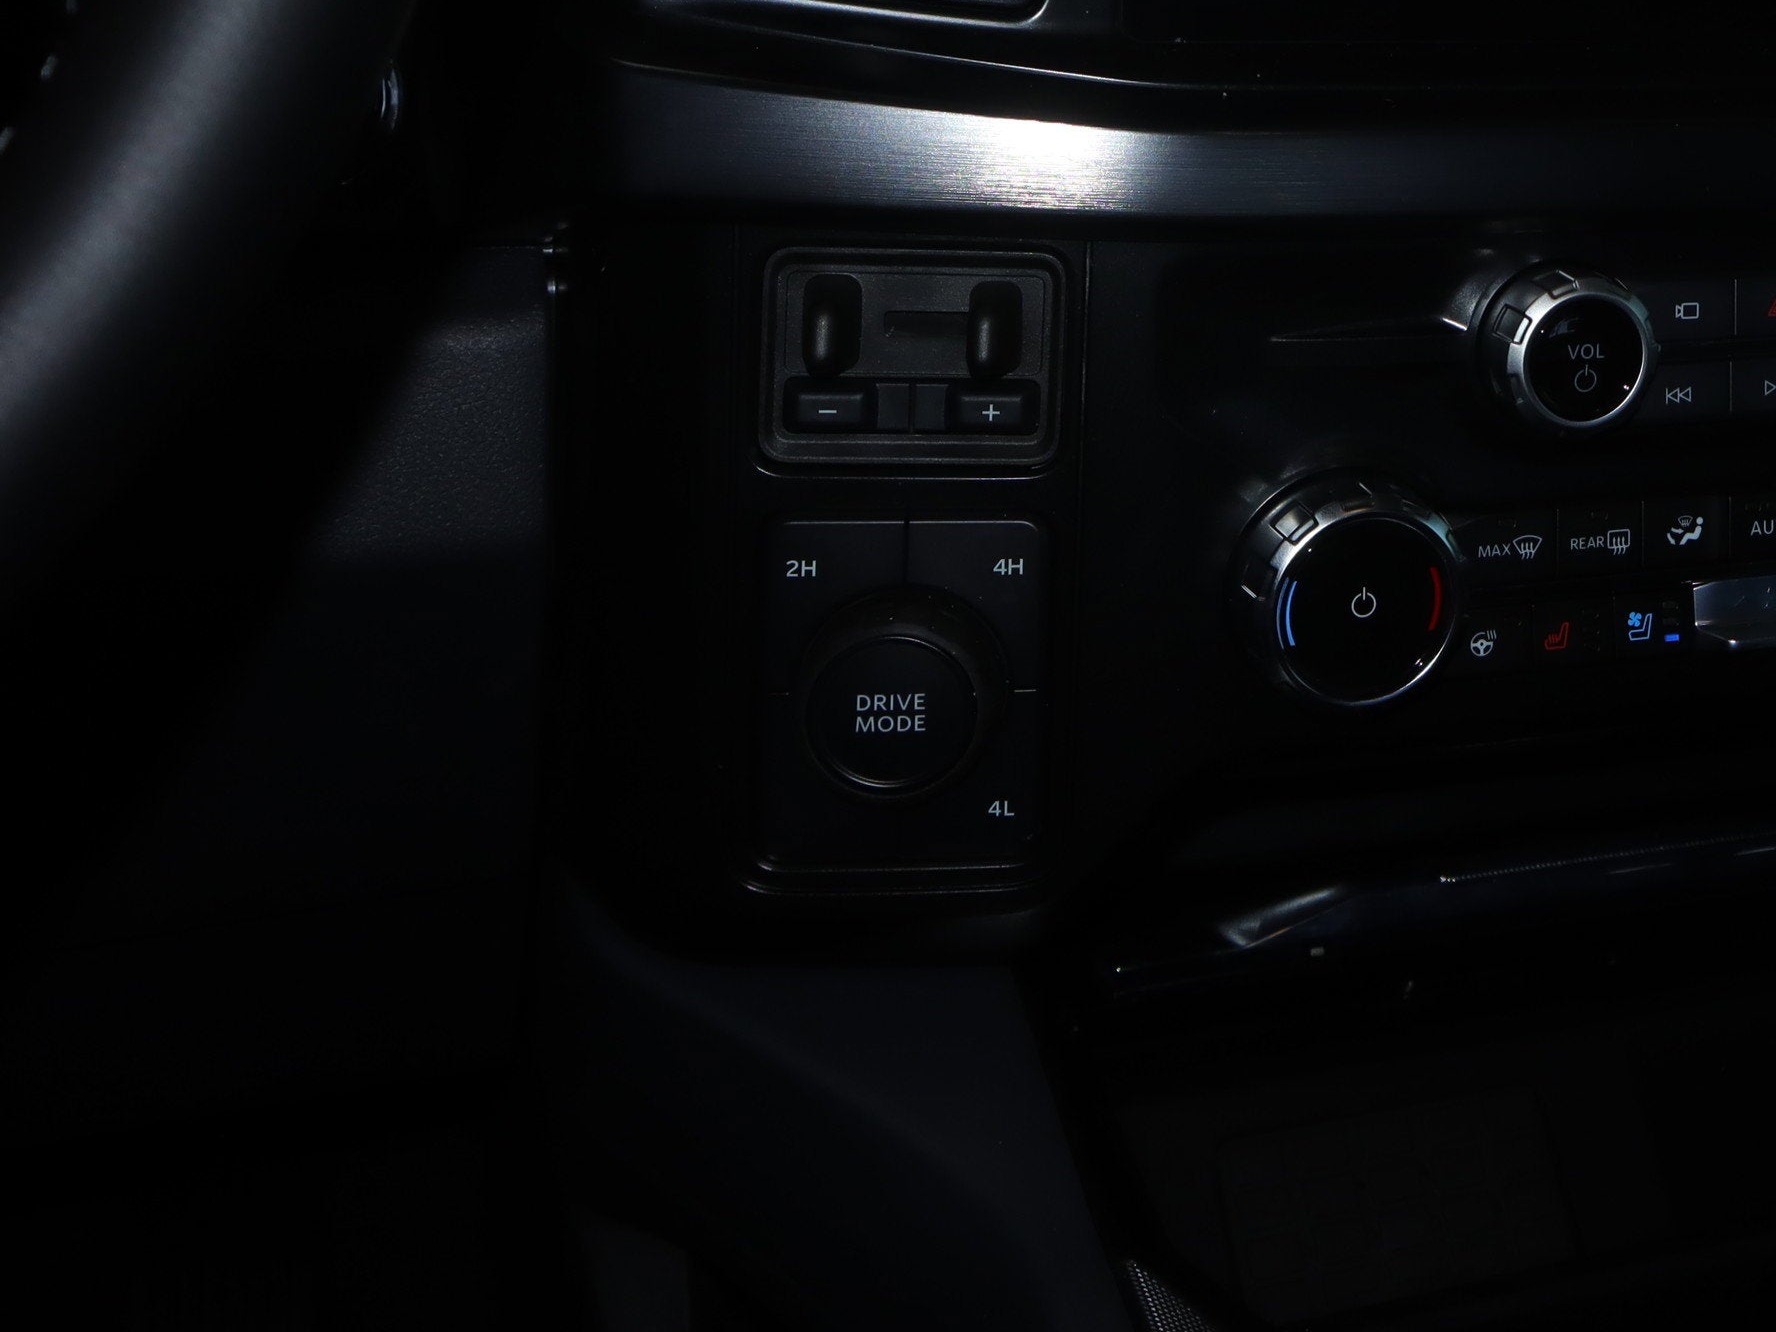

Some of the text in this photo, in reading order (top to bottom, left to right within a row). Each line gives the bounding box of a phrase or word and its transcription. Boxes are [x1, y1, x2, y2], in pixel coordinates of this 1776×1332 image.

[1566, 342, 1606, 361] VOL
[1477, 540, 1512, 558] MAX
[1569, 534, 1605, 552] REAR
[785, 559, 818, 578] 2H
[992, 557, 1025, 576] 4H
[855, 693, 927, 713] DRIVE
[854, 714, 927, 734] MODE
[987, 800, 1016, 818] 4L
